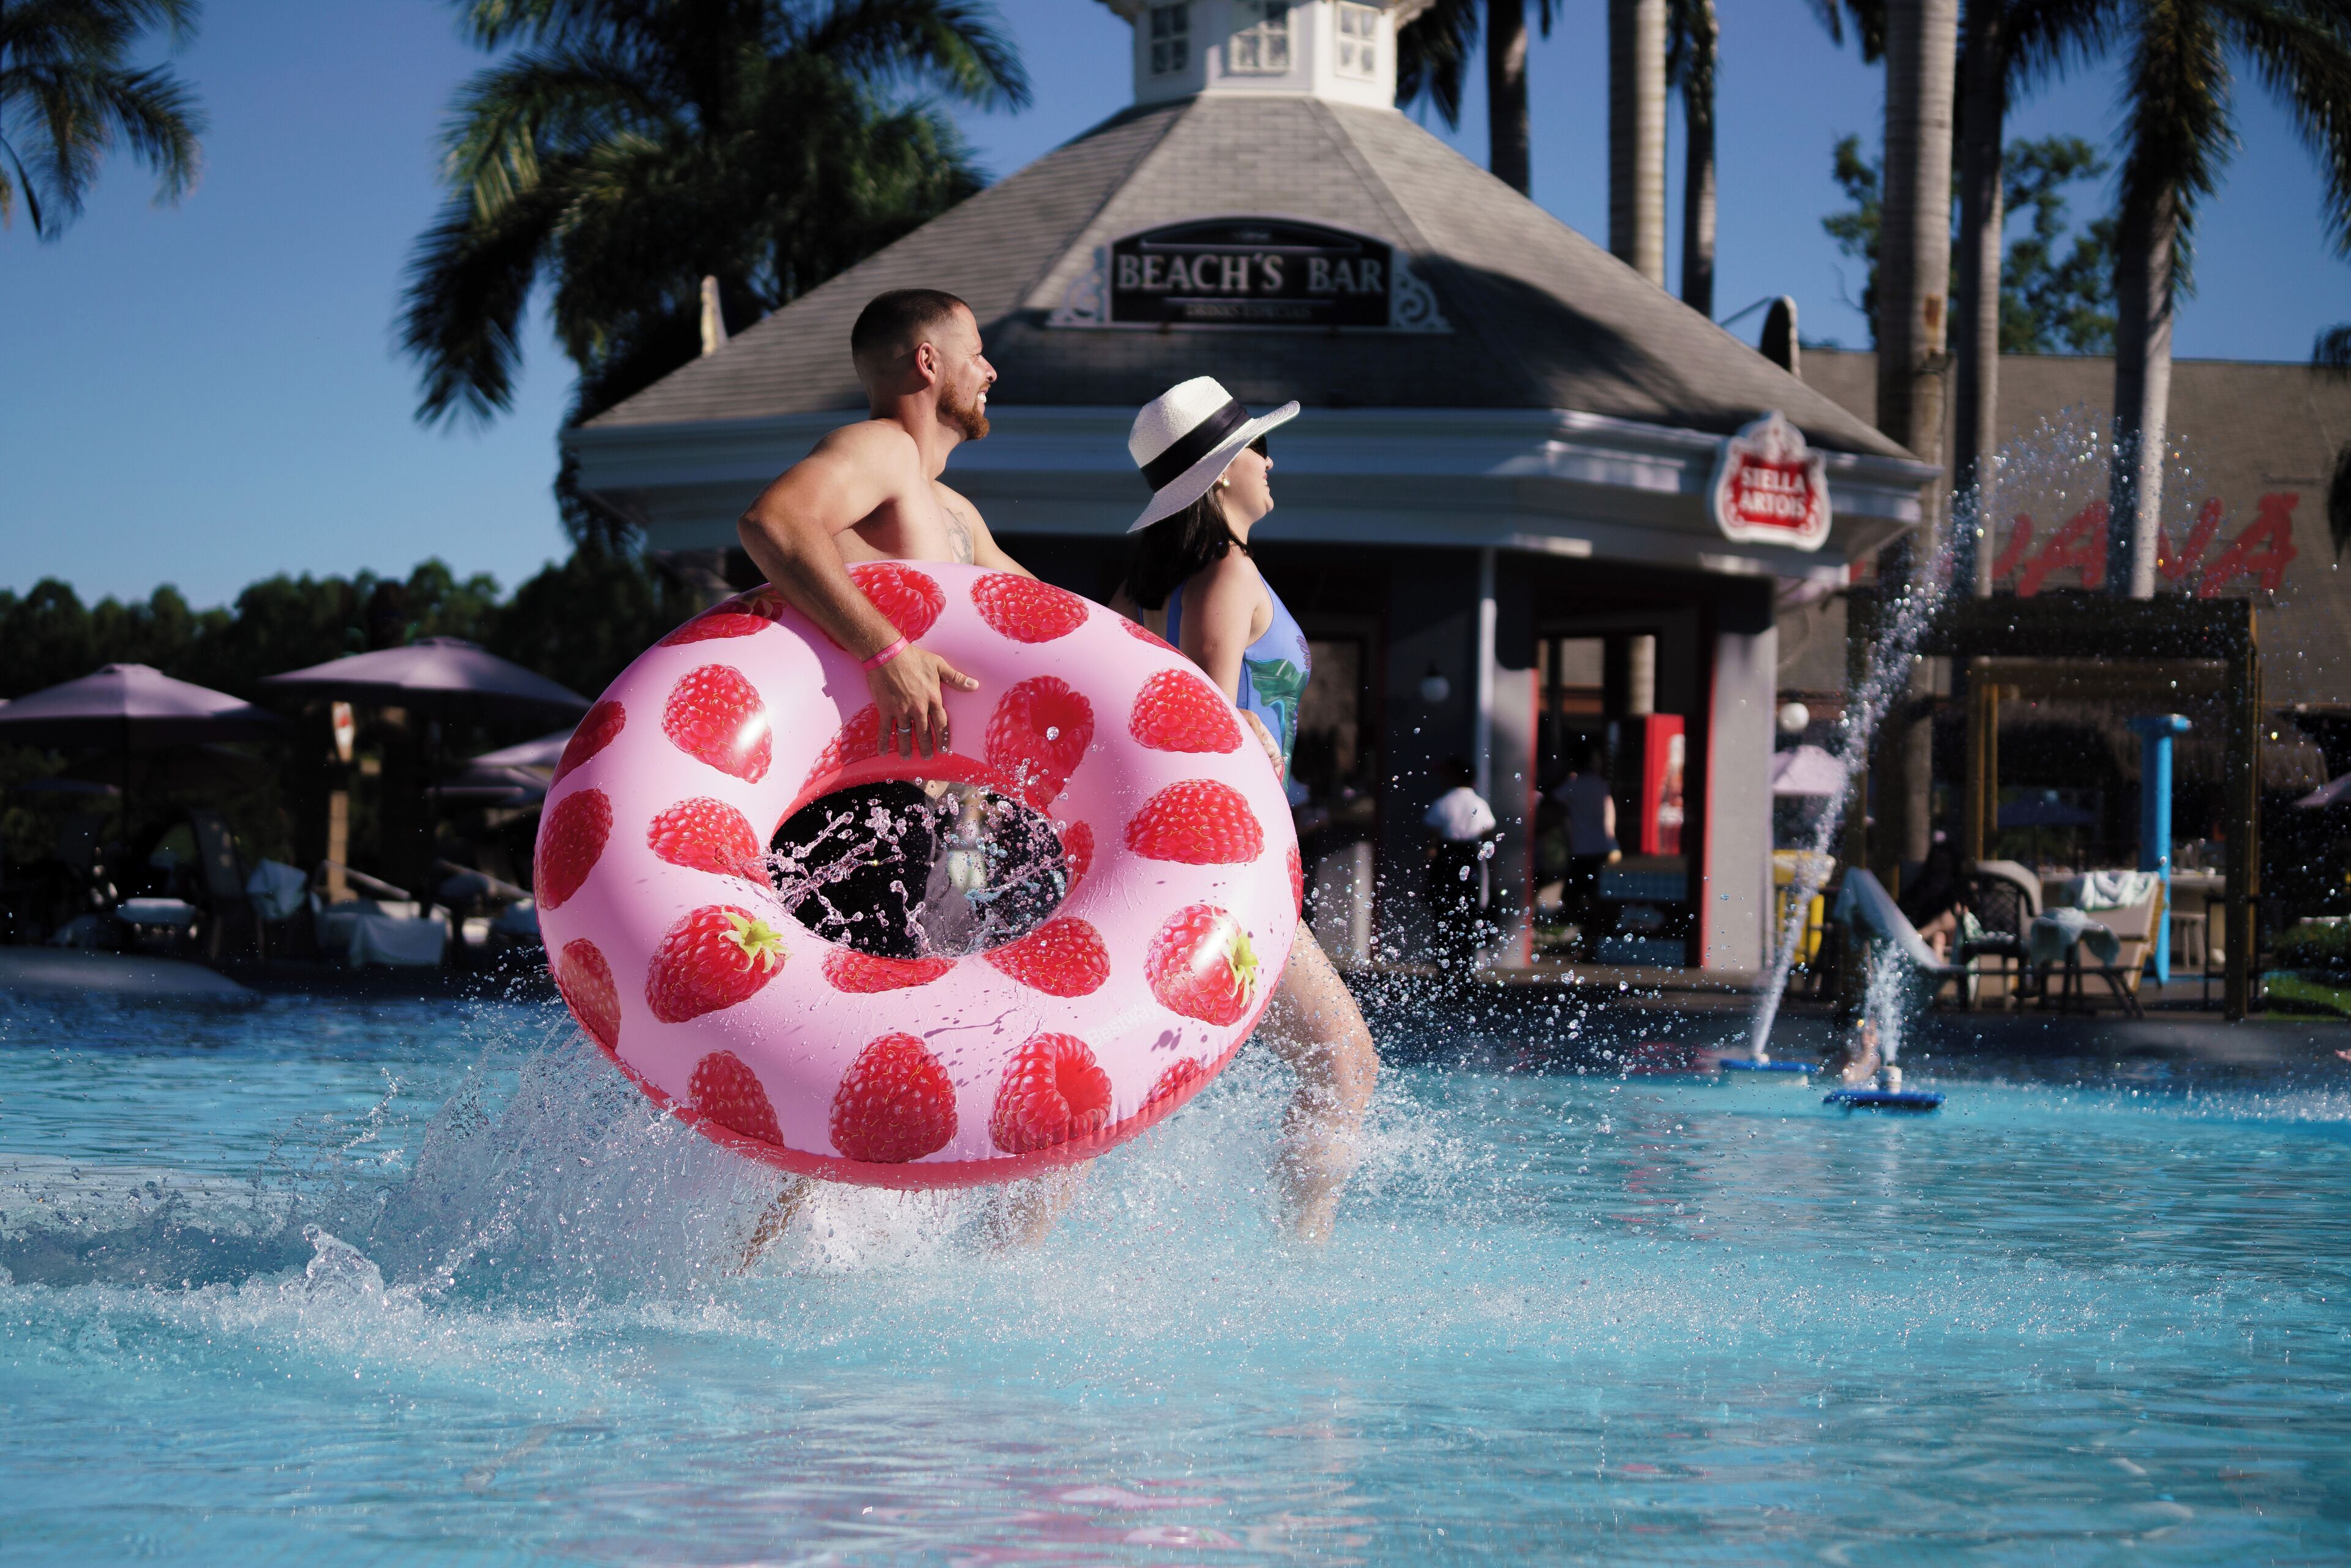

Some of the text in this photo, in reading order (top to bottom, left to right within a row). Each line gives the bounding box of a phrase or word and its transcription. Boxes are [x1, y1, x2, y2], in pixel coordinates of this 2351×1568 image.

[1117, 253, 1384, 293] BEACH'S BAR
[1741, 465, 1805, 493] STELLA
[1739, 490, 1805, 519] ARTOIS
[1082, 999, 1162, 1050] Bestway
